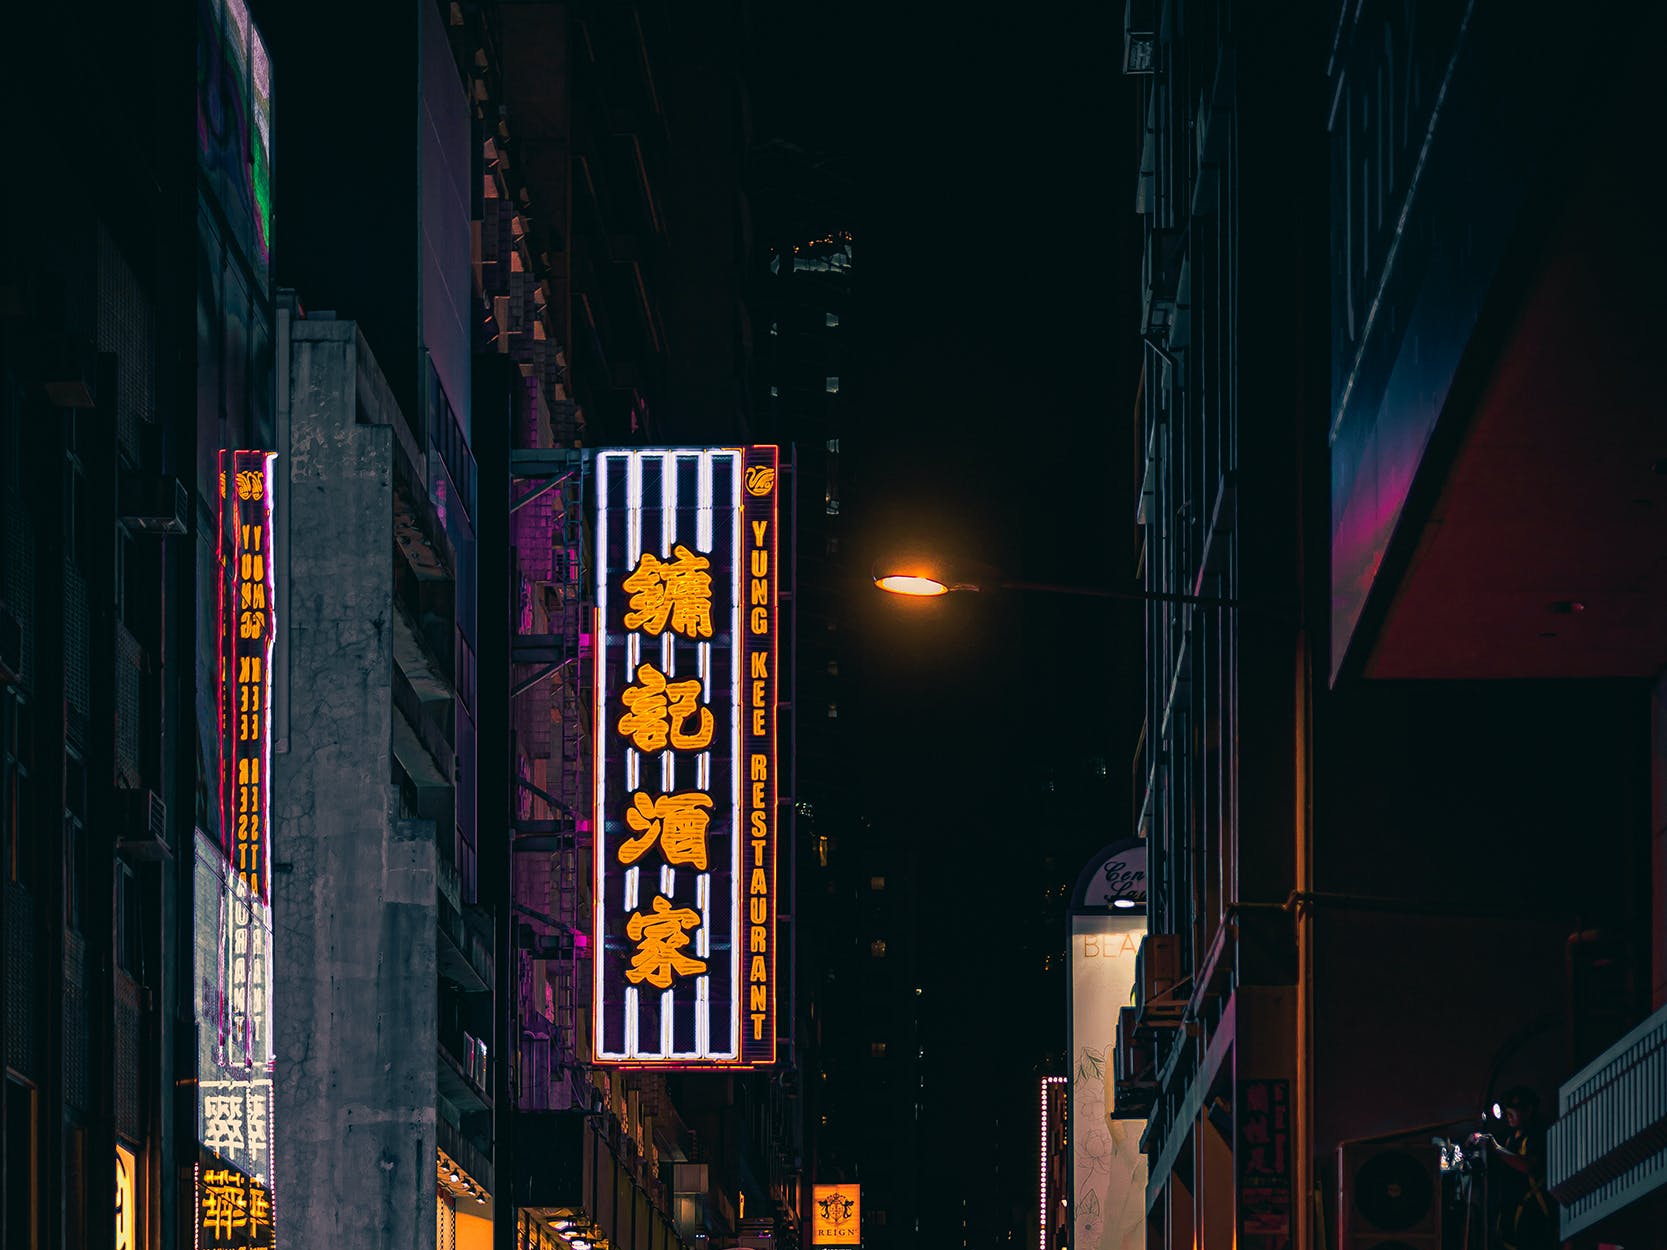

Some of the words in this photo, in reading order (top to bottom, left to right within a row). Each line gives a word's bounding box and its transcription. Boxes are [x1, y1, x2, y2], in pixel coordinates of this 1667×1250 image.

[751, 520, 768, 635] YUNG
[619, 544, 716, 989] 鏞記酒家
[751, 651, 767, 736] KEE
[751, 753, 767, 1041] RESTAURANT
